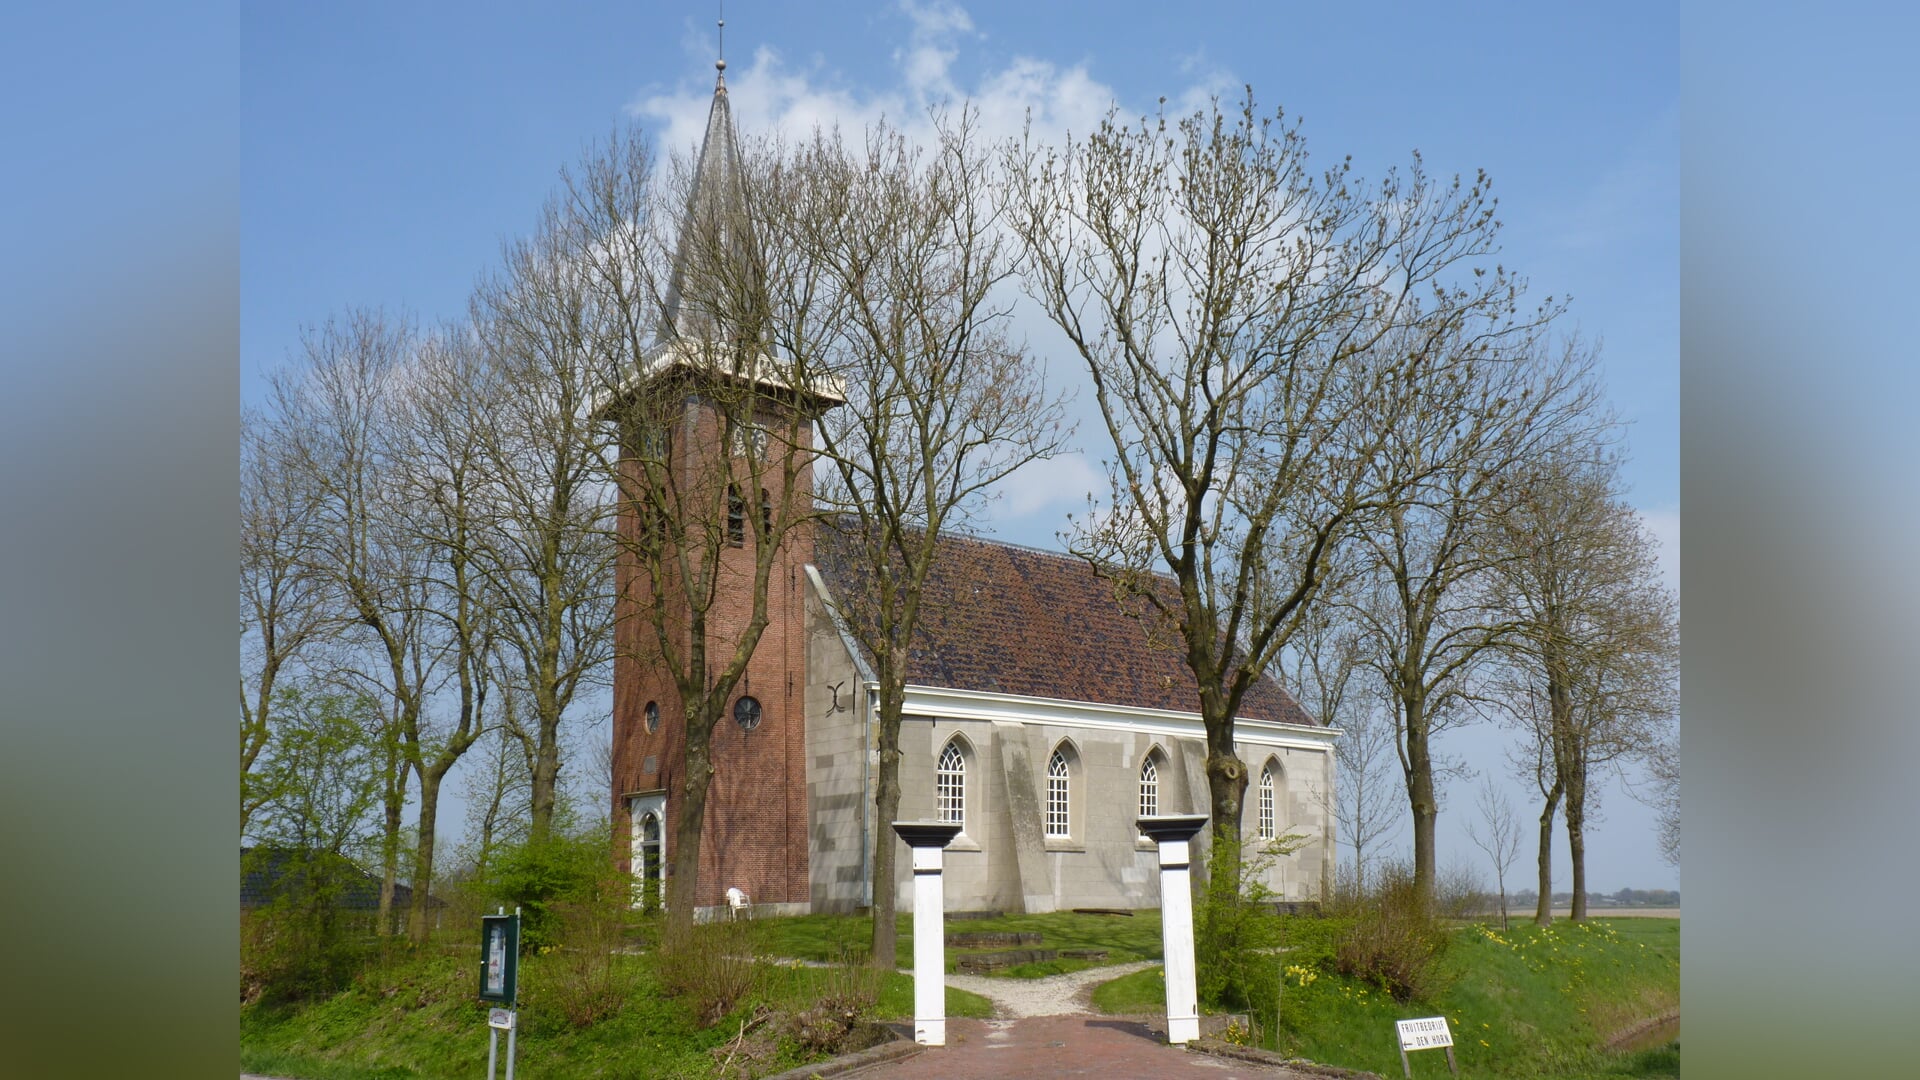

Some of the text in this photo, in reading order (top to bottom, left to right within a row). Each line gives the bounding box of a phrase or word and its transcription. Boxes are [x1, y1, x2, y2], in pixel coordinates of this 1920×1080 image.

[1401, 1020, 1444, 1033] FRUITBEDRIJF
[1416, 1034, 1450, 1046] DEN HORN
